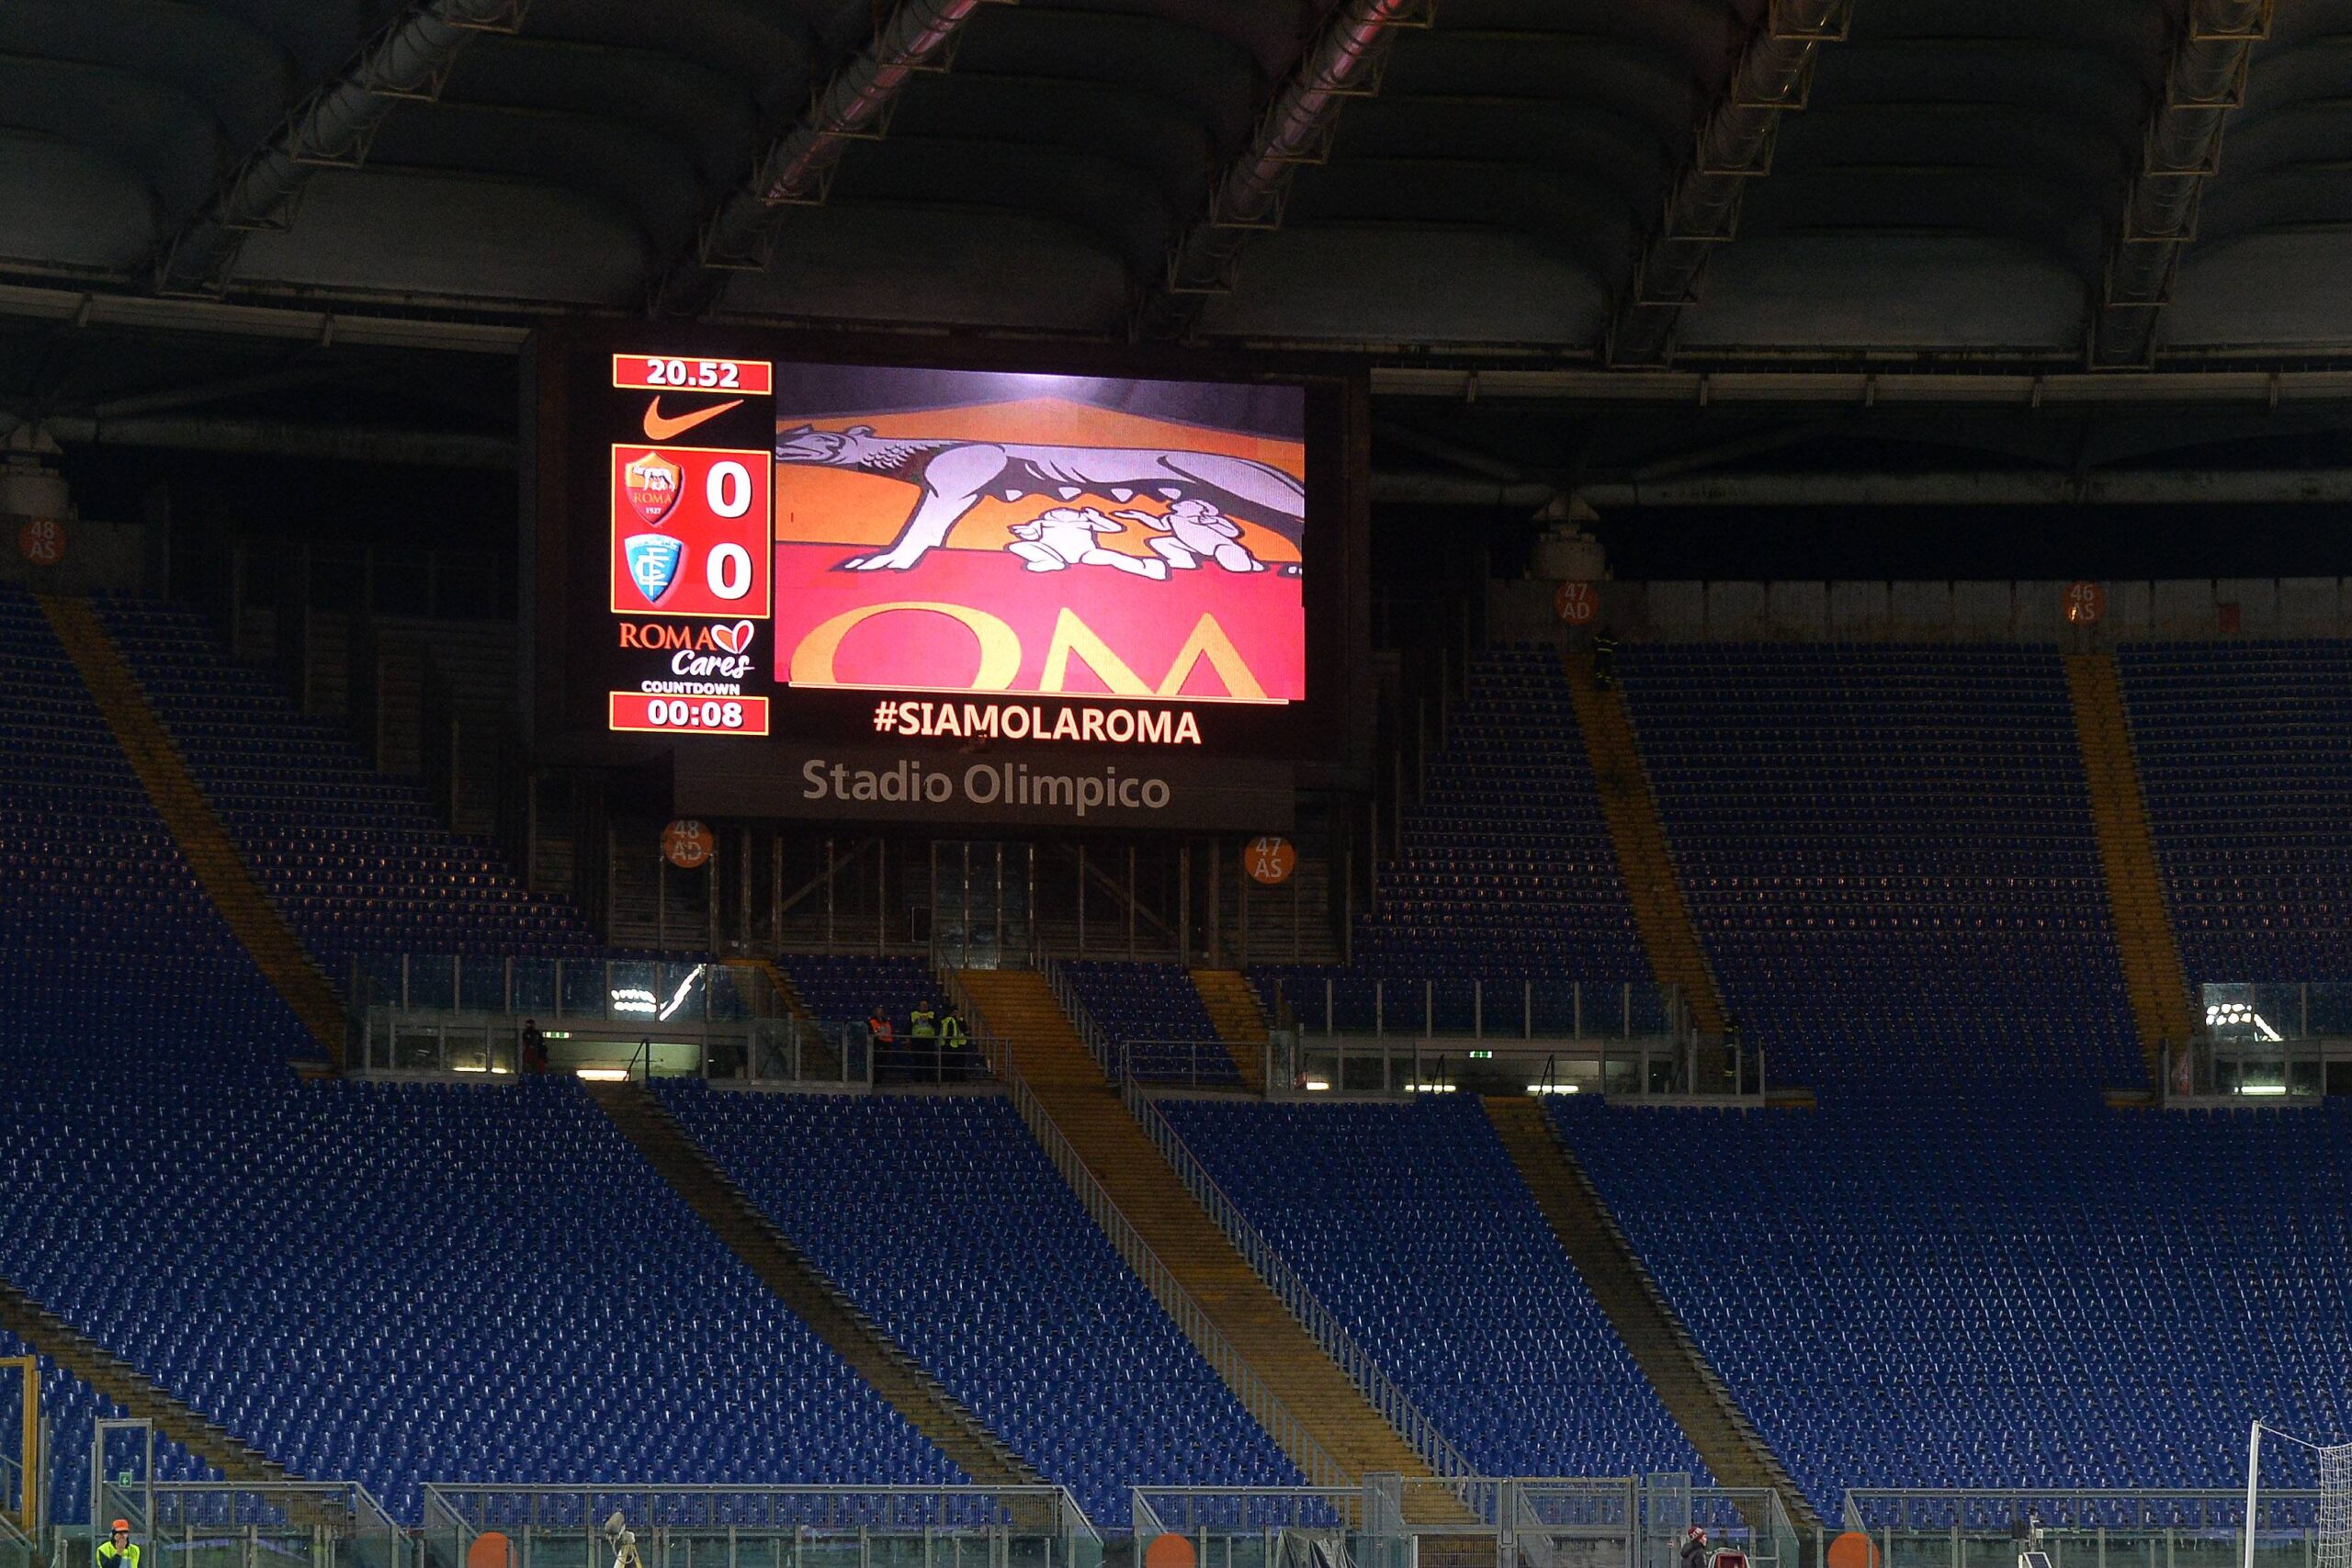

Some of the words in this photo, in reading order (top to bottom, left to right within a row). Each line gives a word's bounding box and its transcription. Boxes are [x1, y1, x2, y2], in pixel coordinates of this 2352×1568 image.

[646, 359, 740, 388] 20.52
[633, 491, 673, 503] ROMA
[706, 460, 752, 517] 0
[30, 521, 54, 539] 48
[29, 541, 56, 559] AS
[706, 542, 752, 600] 0
[1565, 583, 1588, 601] 47
[2071, 584, 2094, 602] 46
[1563, 602, 1589, 619] AD
[619, 623, 718, 650] ROMA
[671, 649, 755, 679] Cares
[641, 680, 741, 696] COUNTDOWN
[647, 699, 743, 728] 00:08
[873, 701, 1203, 745] #SIAMOLAROMA
[803, 759, 953, 802] Stadio
[964, 763, 1171, 816] Olimpico
[673, 820, 699, 839] 48
[672, 841, 702, 861] AD
[1255, 837, 1282, 856] 47
[1254, 858, 1283, 878] AS
